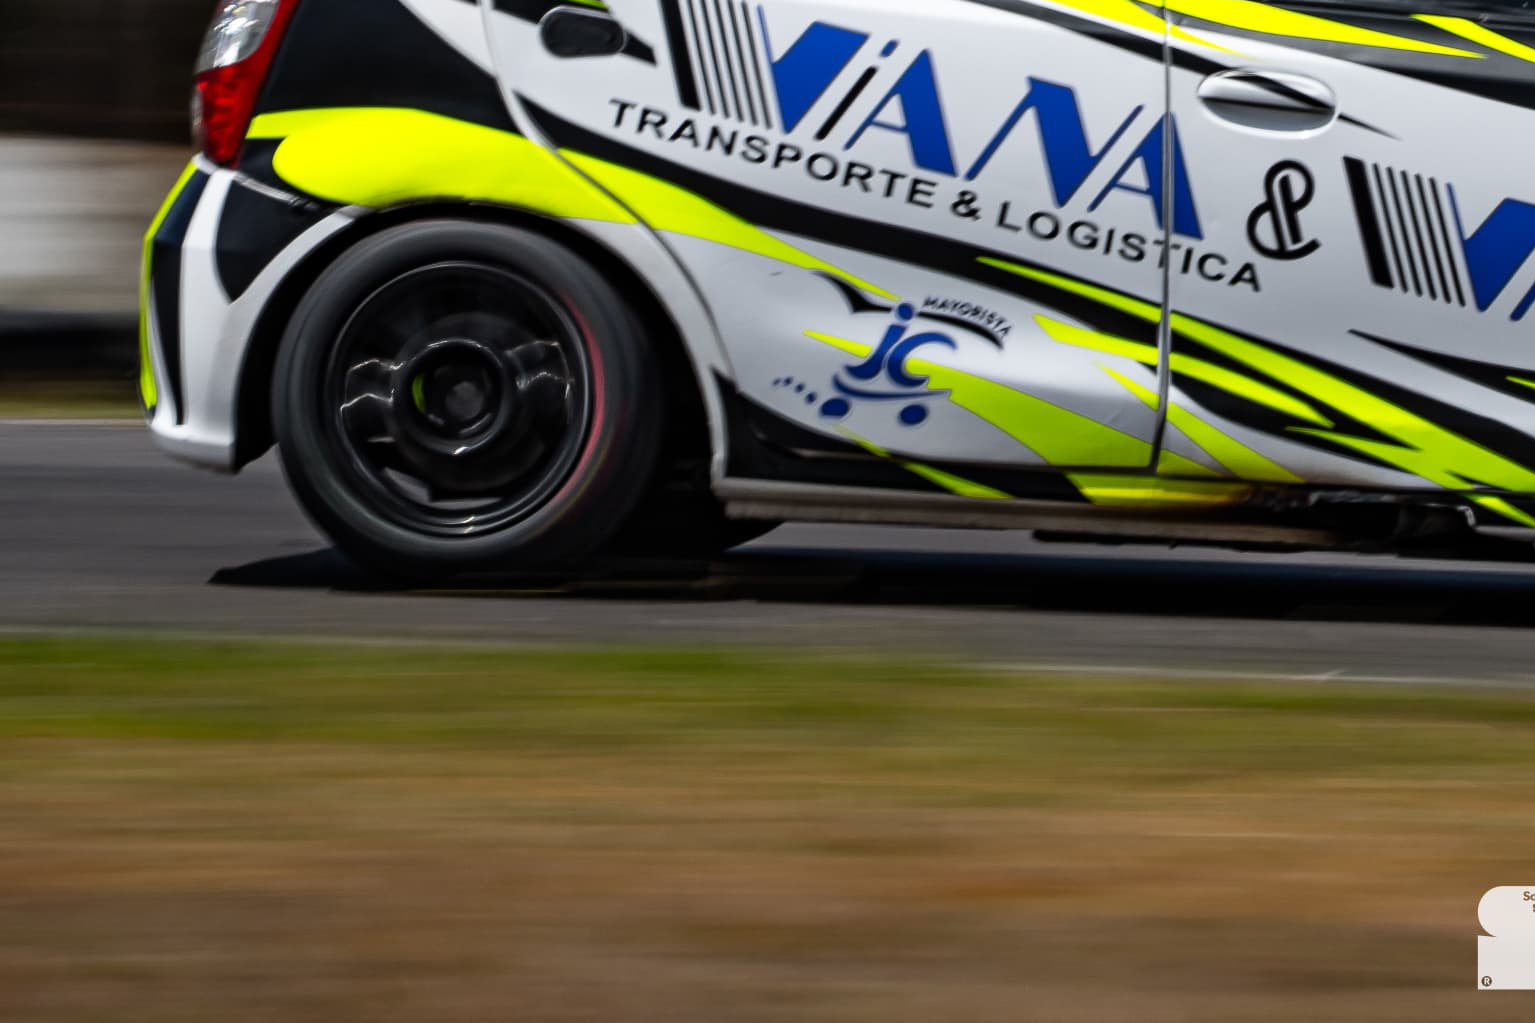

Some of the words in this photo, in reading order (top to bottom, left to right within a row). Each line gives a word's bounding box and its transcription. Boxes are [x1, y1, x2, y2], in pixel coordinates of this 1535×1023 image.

[609, 97, 939, 209] TRANSPORTE
[951, 189, 982, 222] &
[997, 201, 1264, 293] LOGISTICA
[922, 295, 1014, 340] MAYORISTA
